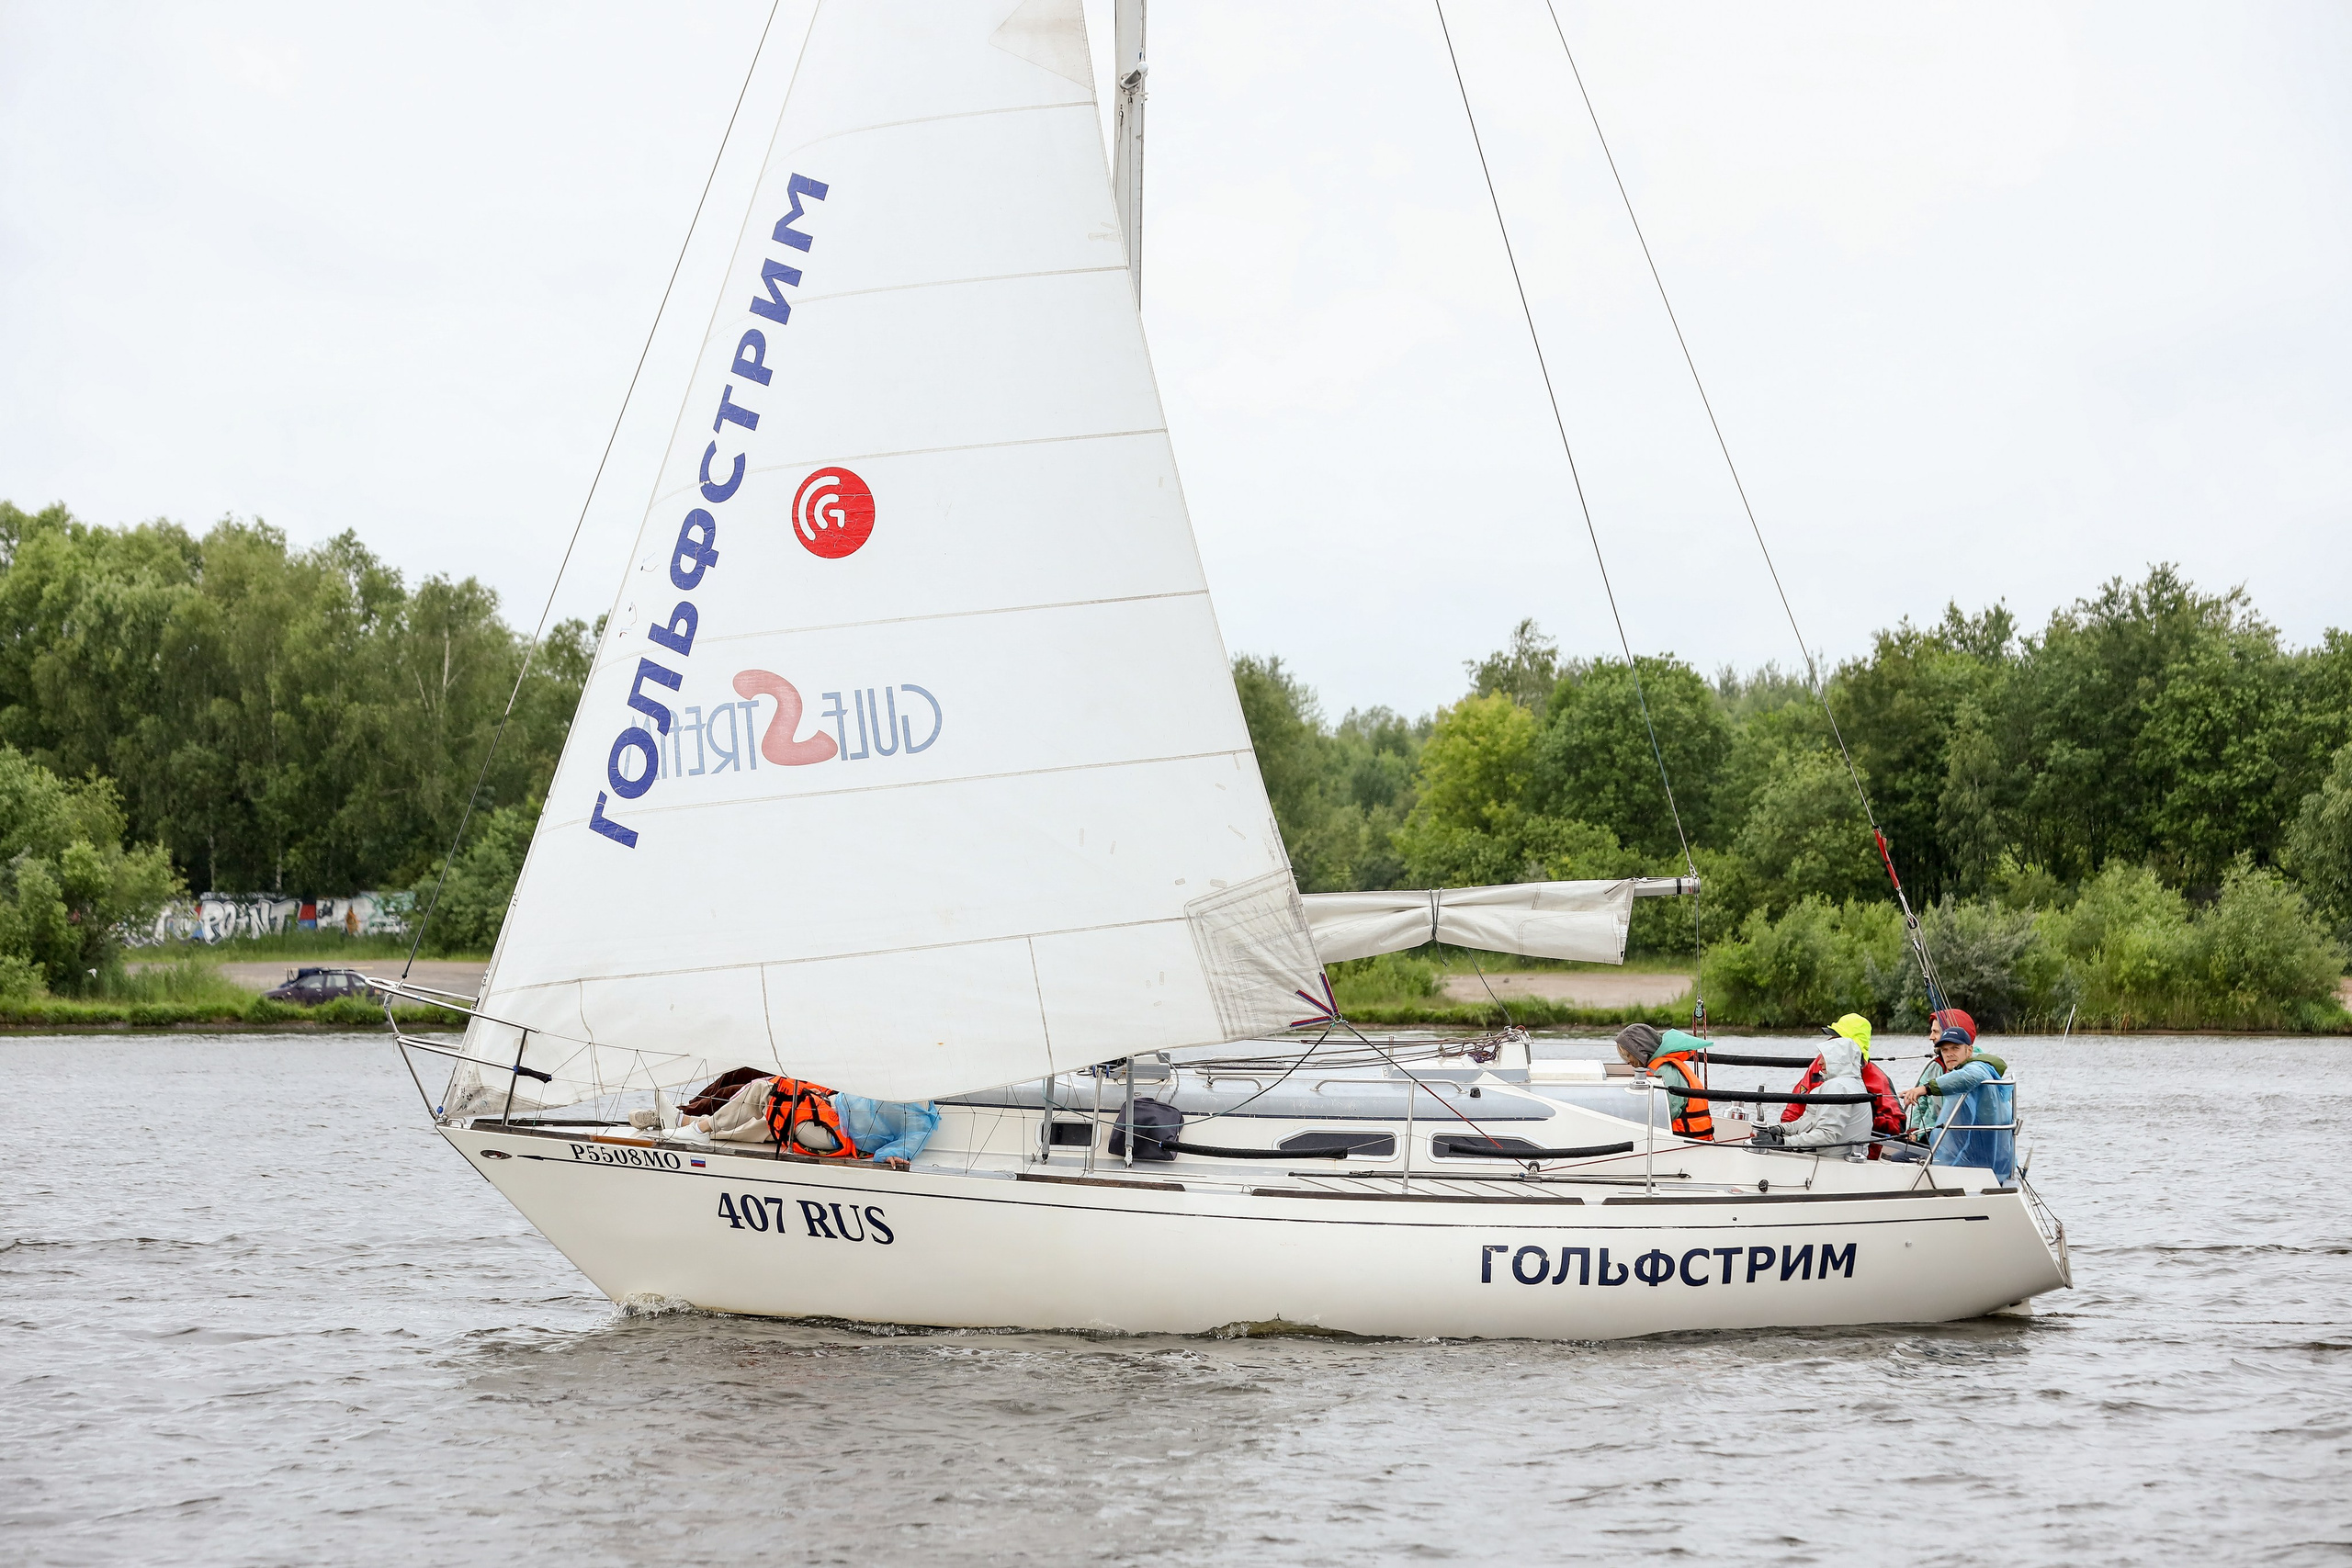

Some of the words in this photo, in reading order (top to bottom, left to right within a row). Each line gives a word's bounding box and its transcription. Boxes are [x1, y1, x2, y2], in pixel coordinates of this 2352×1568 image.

[589, 172, 830, 850] ГОЛЬФСТРИМ
[718, 1192, 786, 1235] 407
[796, 1199, 895, 1246] RUS
[1481, 1242, 1858, 1287] ГОЛЬФСТРИМ
